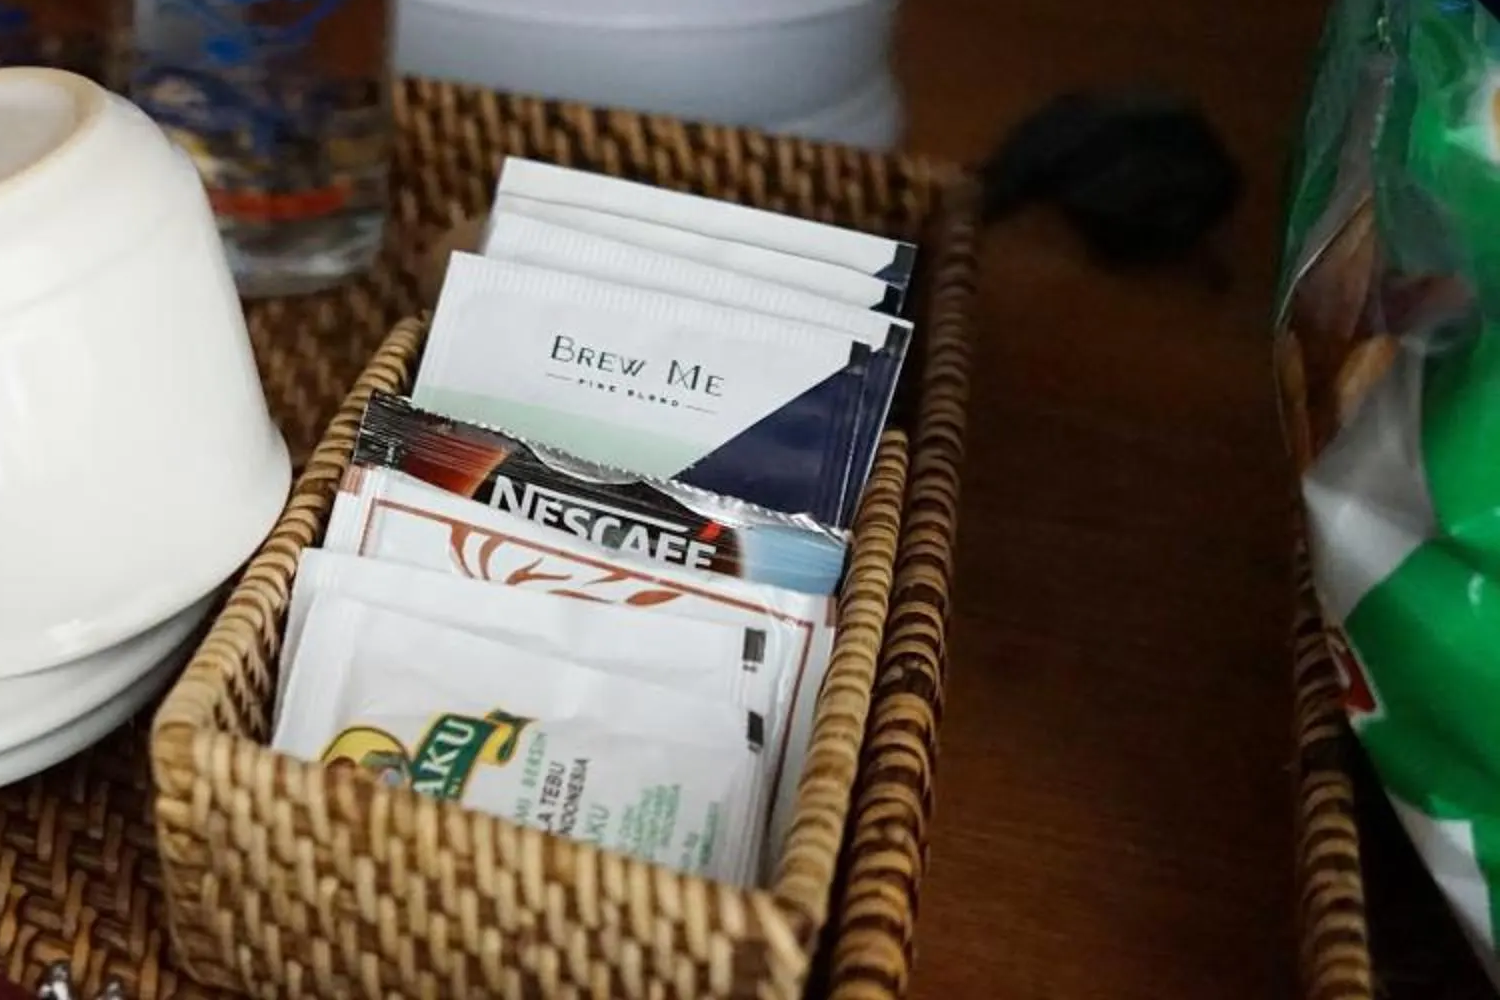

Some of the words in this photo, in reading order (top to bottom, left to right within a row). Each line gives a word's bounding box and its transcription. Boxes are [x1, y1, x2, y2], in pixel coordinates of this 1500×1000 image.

[551, 335, 647, 377] BREW
[666, 359, 725, 397] ME
[539, 760, 566, 807] TEBU
[558, 757, 592, 835] NDONESIA
